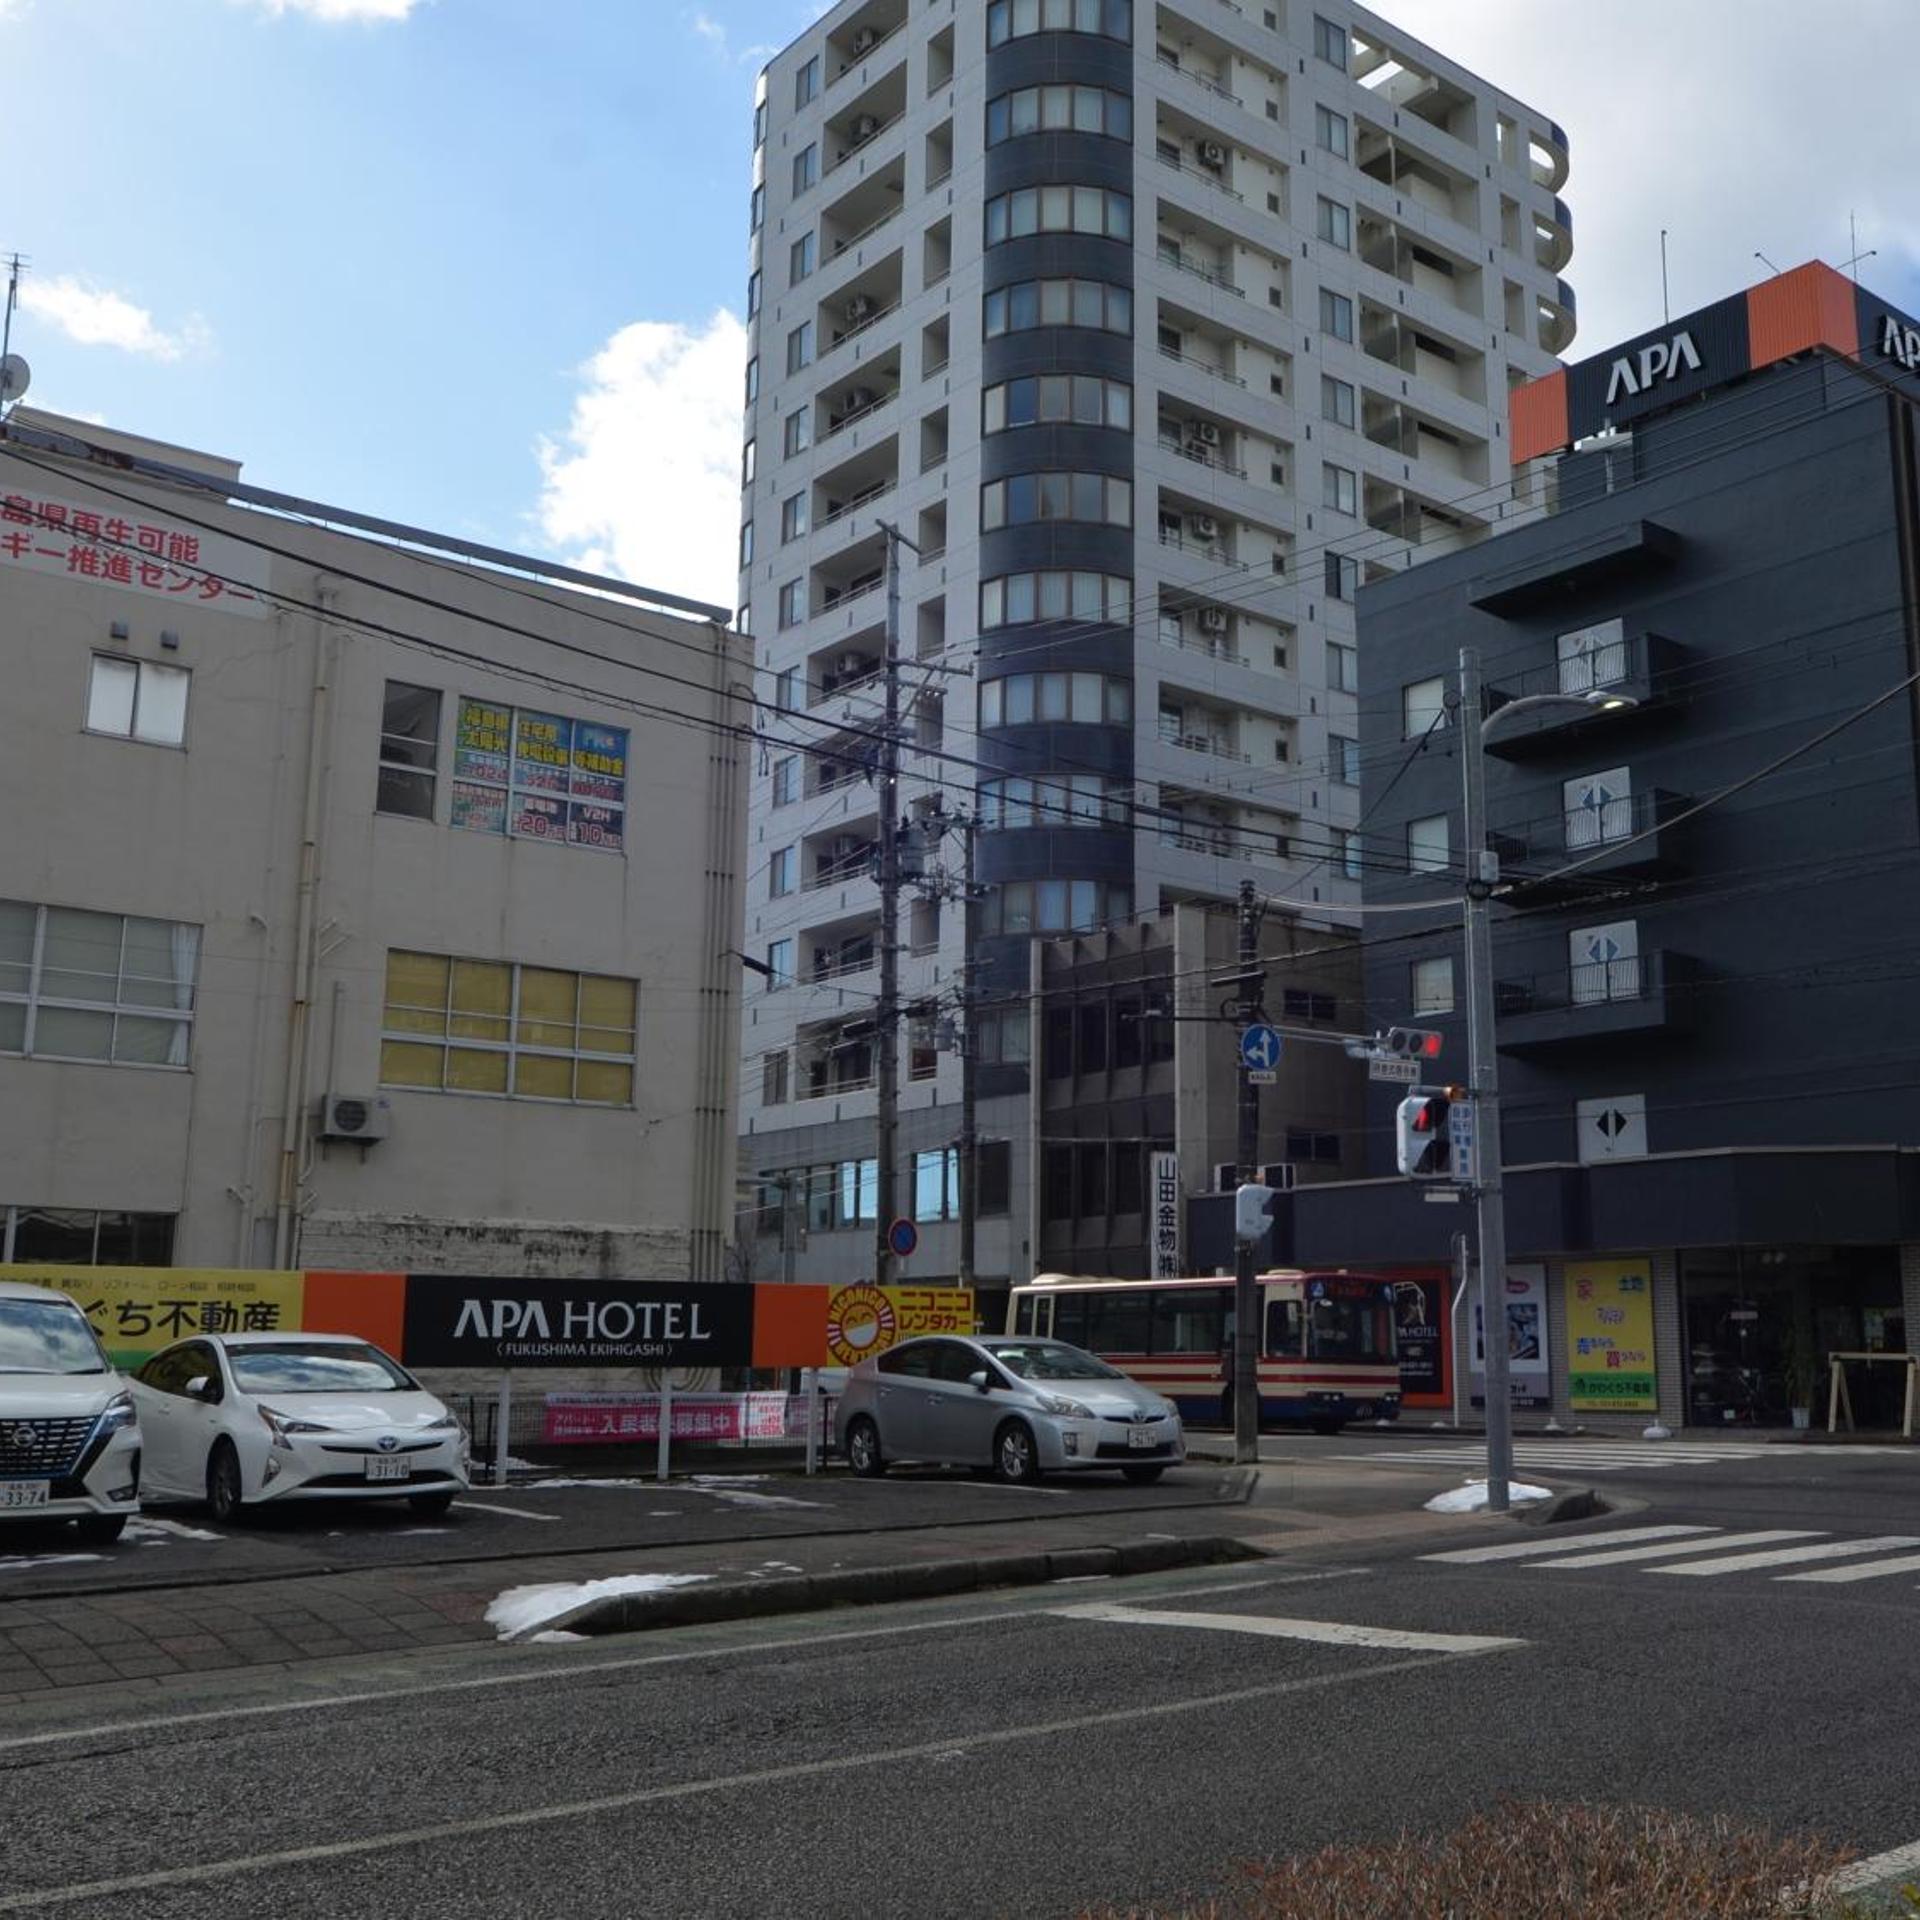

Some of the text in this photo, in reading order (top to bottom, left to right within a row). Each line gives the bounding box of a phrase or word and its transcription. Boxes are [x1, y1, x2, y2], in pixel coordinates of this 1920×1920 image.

[1606, 331, 1702, 405] APA
[0, 494, 200, 565] 島県再生可能
[1, 530, 256, 601] ギー推進センター
[453, 1299, 711, 1340] APA HOTEL
[899, 1291, 971, 1312] ニコニコ
[899, 1313, 970, 1330] レンタカー
[6, 1490, 46, 1506] 33-74
